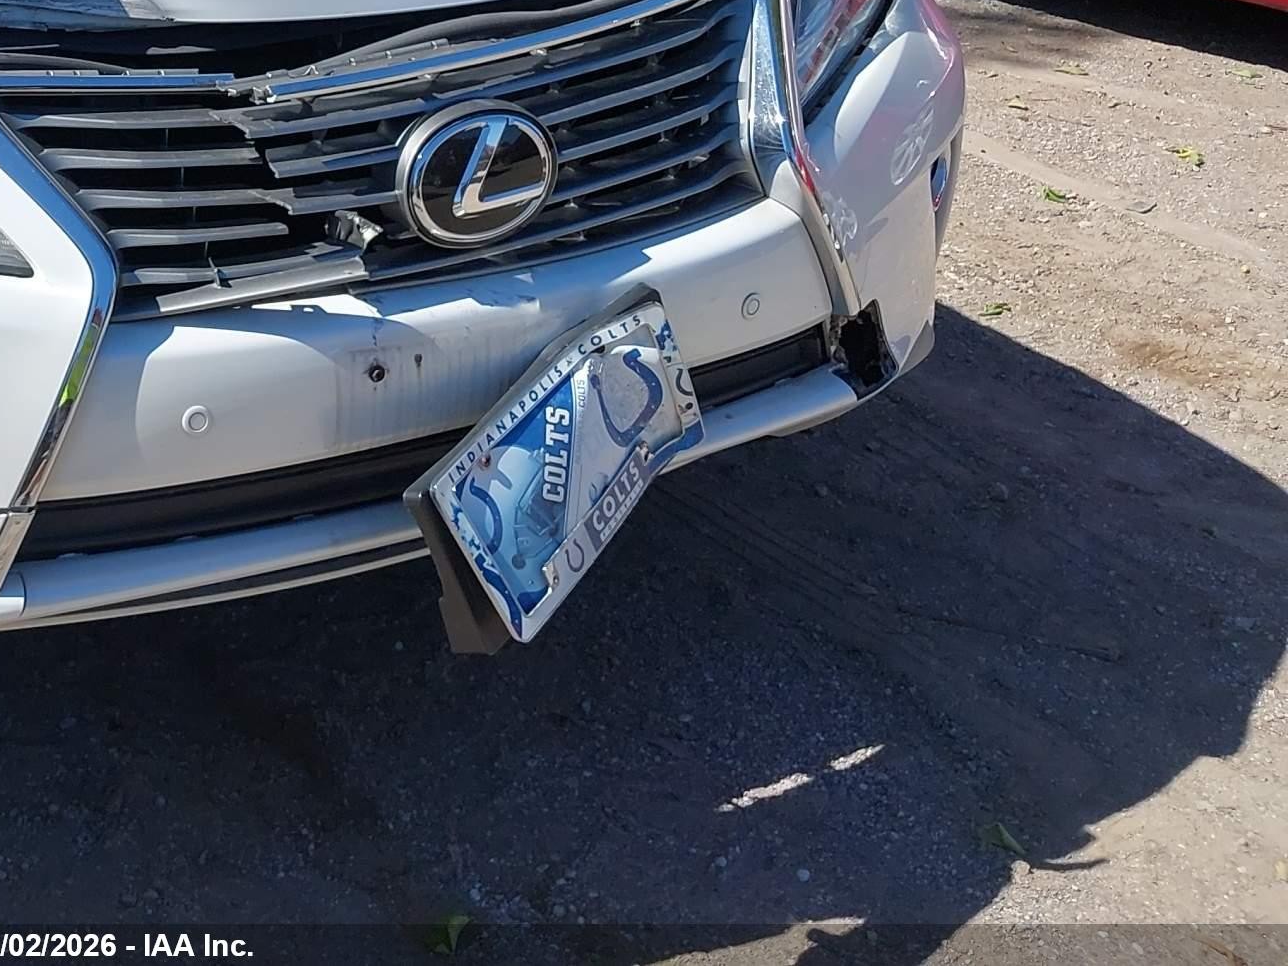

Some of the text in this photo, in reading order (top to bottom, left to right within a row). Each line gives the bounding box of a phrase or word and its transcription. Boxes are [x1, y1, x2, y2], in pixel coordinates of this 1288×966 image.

[447, 315, 641, 483] INDIANAPOLIS COLTS
[542, 406, 571, 504] COLTS
[592, 461, 640, 531] COLTS
